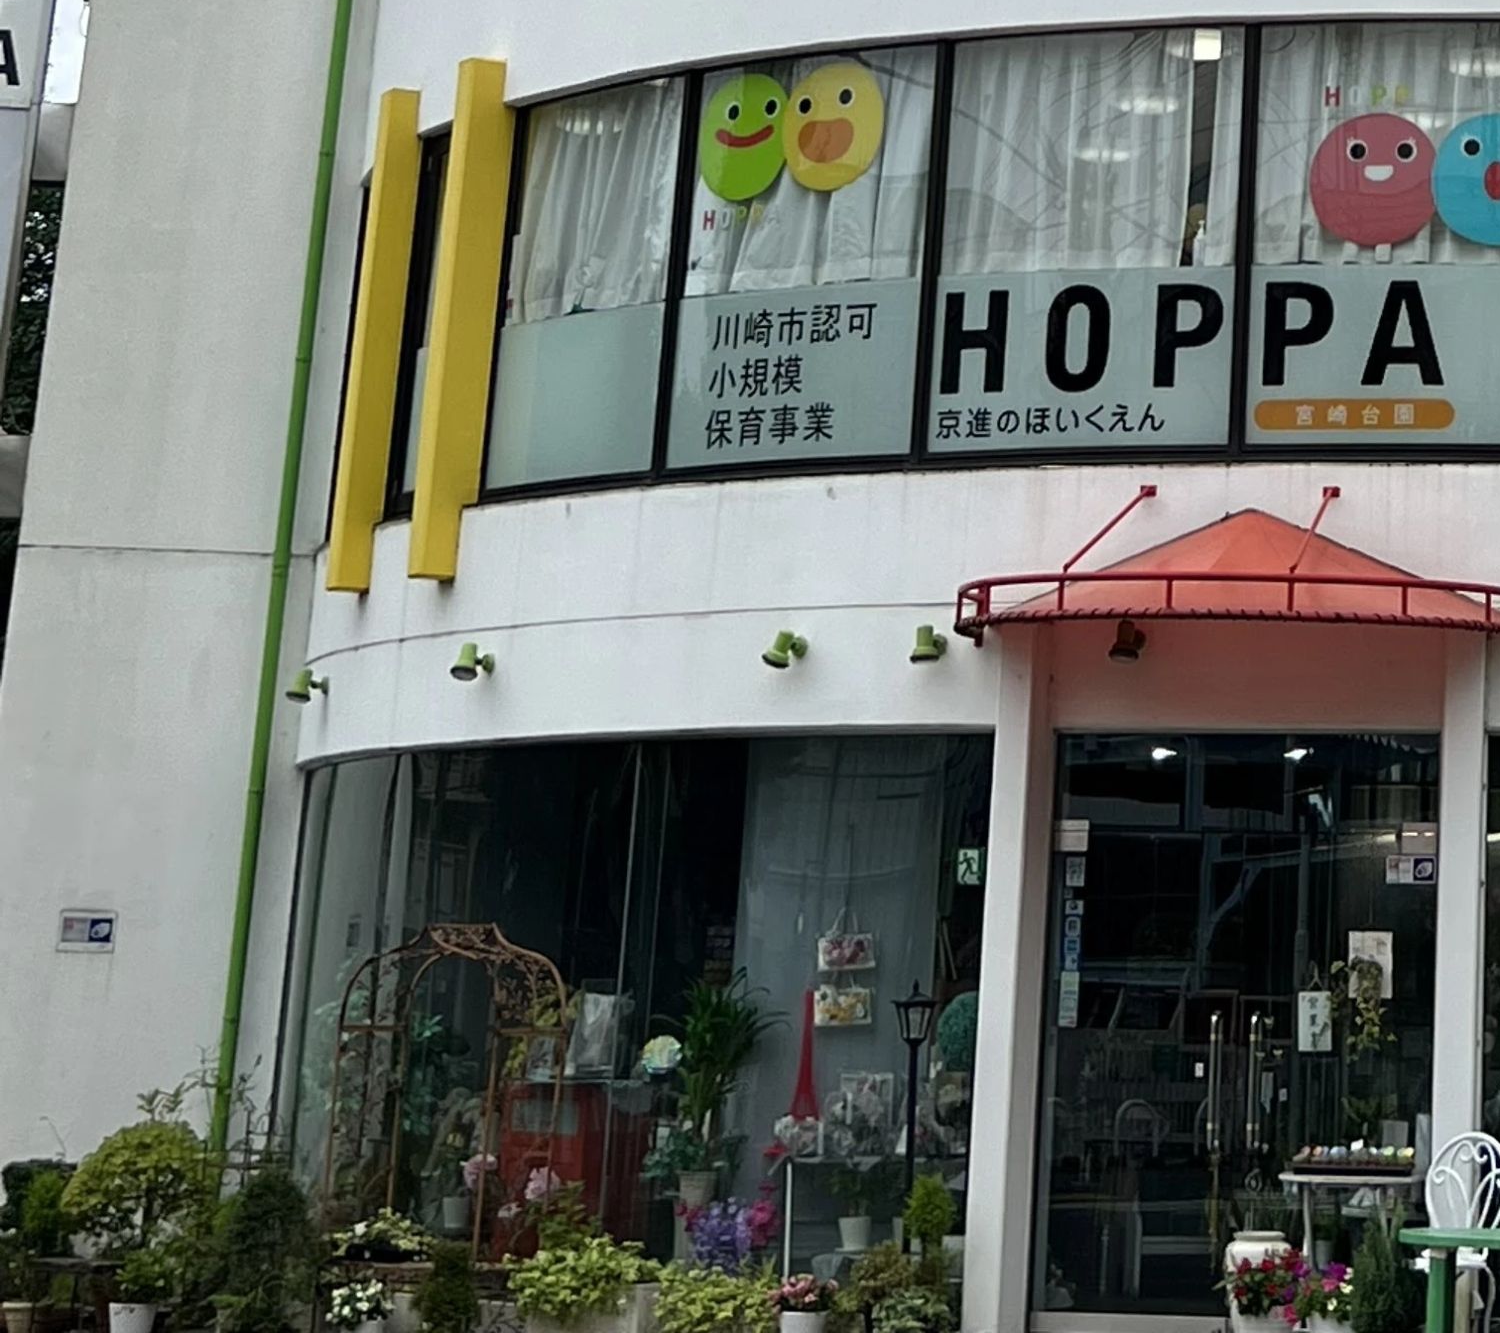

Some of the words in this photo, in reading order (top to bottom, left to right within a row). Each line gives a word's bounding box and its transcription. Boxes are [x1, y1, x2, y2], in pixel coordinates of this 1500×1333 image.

[712, 303, 878, 351] 川崎市認可
[939, 279, 1446, 395] HOPPA
[708, 353, 804, 400] 小規模
[704, 401, 836, 450] 保育事業
[935, 403, 1166, 440] 京進のほいくえん
[1295, 403, 1416, 426] 宮崎台園
